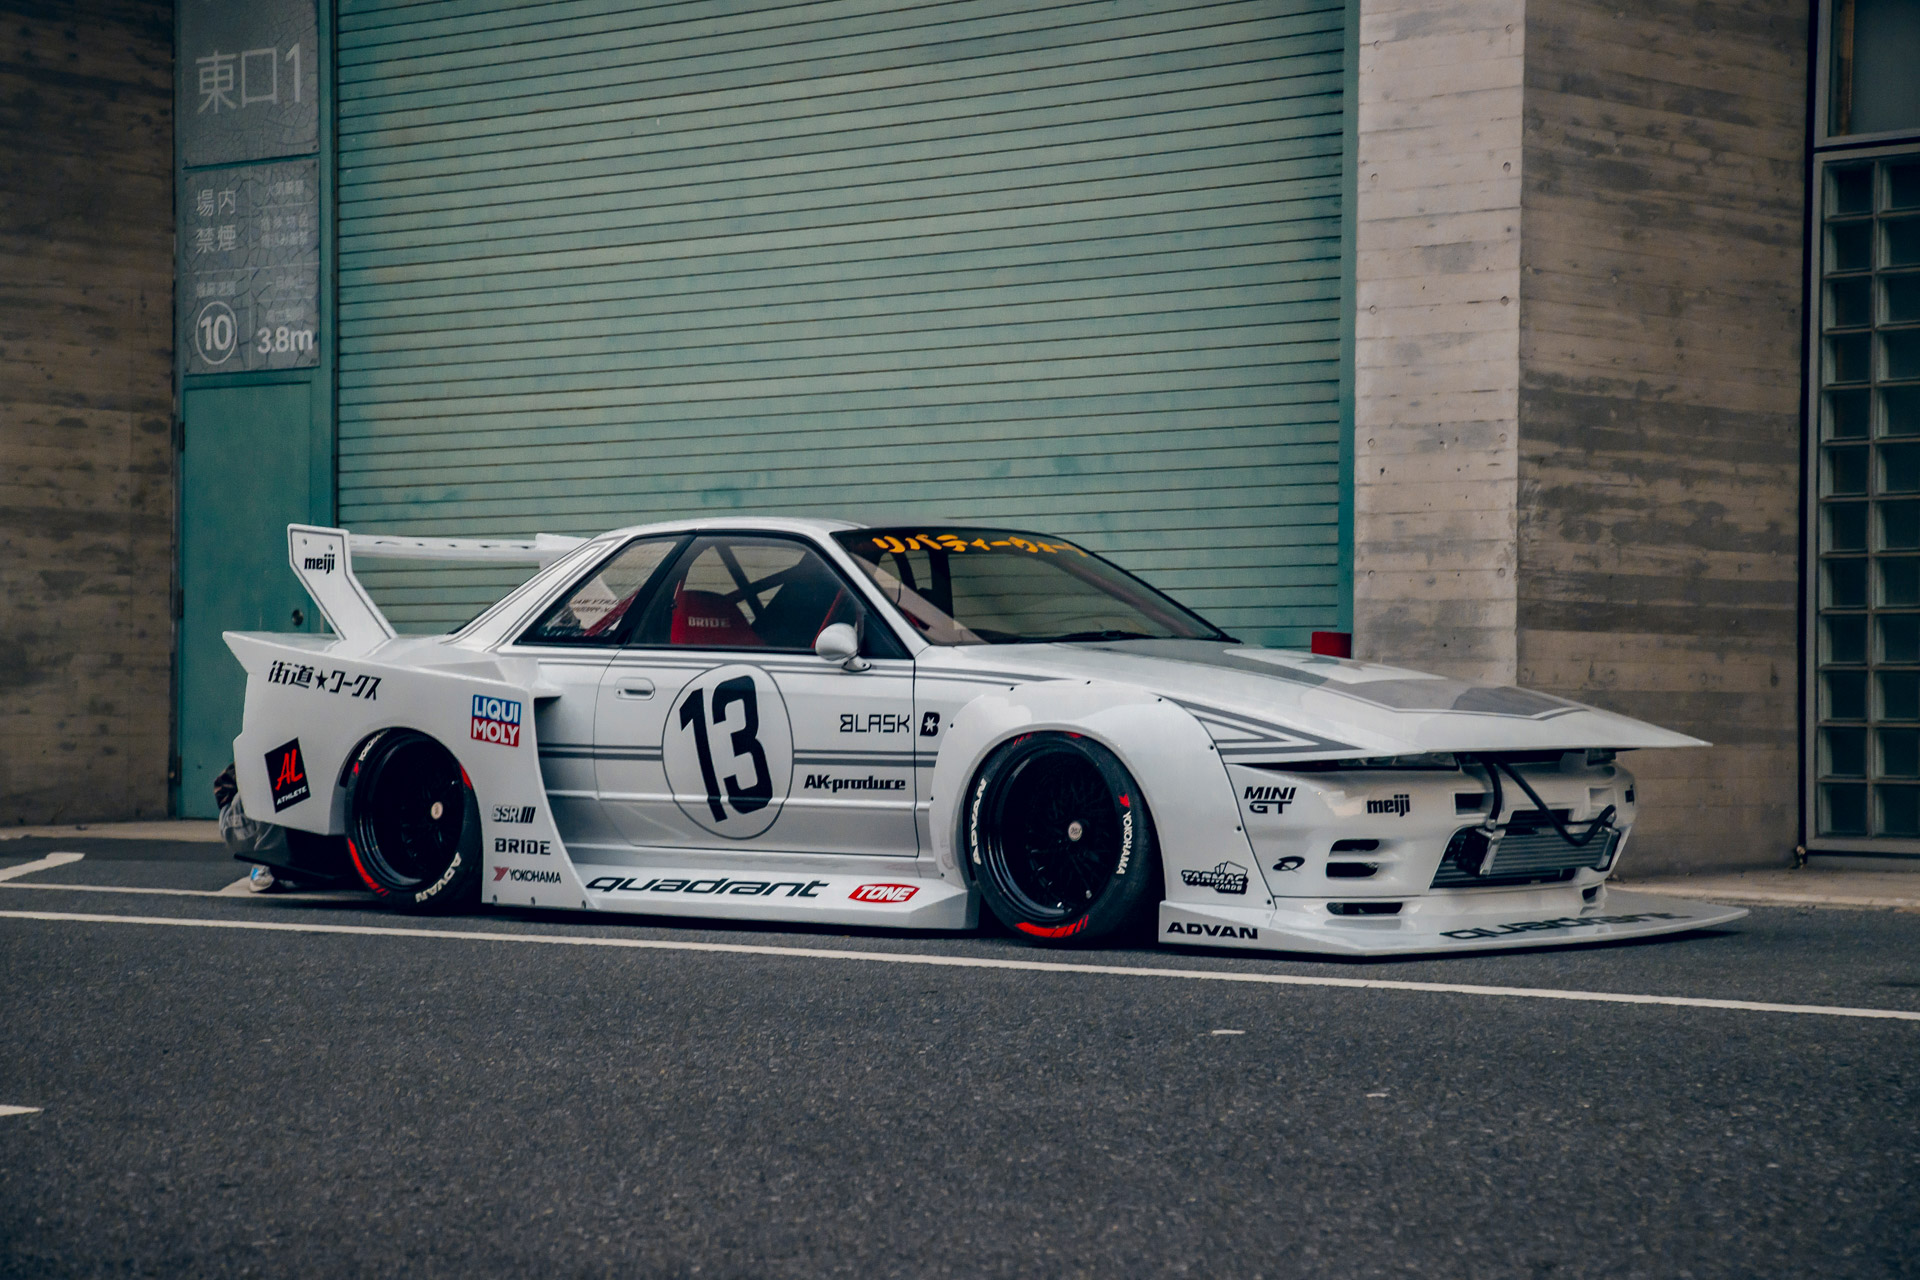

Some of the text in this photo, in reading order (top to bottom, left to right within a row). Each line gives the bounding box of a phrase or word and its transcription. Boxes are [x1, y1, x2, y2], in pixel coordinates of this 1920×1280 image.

[195, 43, 300, 114] 東口1
[196, 188, 237, 217] 場内
[196, 224, 237, 253] 禁煙
[200, 314, 233, 351] 10
[257, 326, 314, 354] 3.8m
[304, 553, 336, 575] meiji
[474, 696, 520, 723] LIQUI
[472, 718, 519, 746] MOLY
[840, 713, 910, 733] BLASK
[679, 675, 773, 823] 13
[275, 749, 303, 791] AL
[277, 785, 307, 805] ATHLETE
[1244, 786, 1297, 800] MINI
[1249, 801, 1292, 814] GT
[1367, 794, 1410, 817] meiji
[971, 777, 988, 865] ADVAN
[494, 838, 551, 855] BRIDE
[1116, 811, 1133, 875] YOKOHAMA
[415, 852, 462, 903] ADVAN
[509, 868, 561, 884] YOKOHAMA
[586, 877, 829, 898] quadrant
[1182, 870, 1245, 885] TARMAC
[1214, 883, 1243, 892] CARDS
[857, 887, 914, 902] TONE
[1167, 922, 1258, 939] ADVAN
